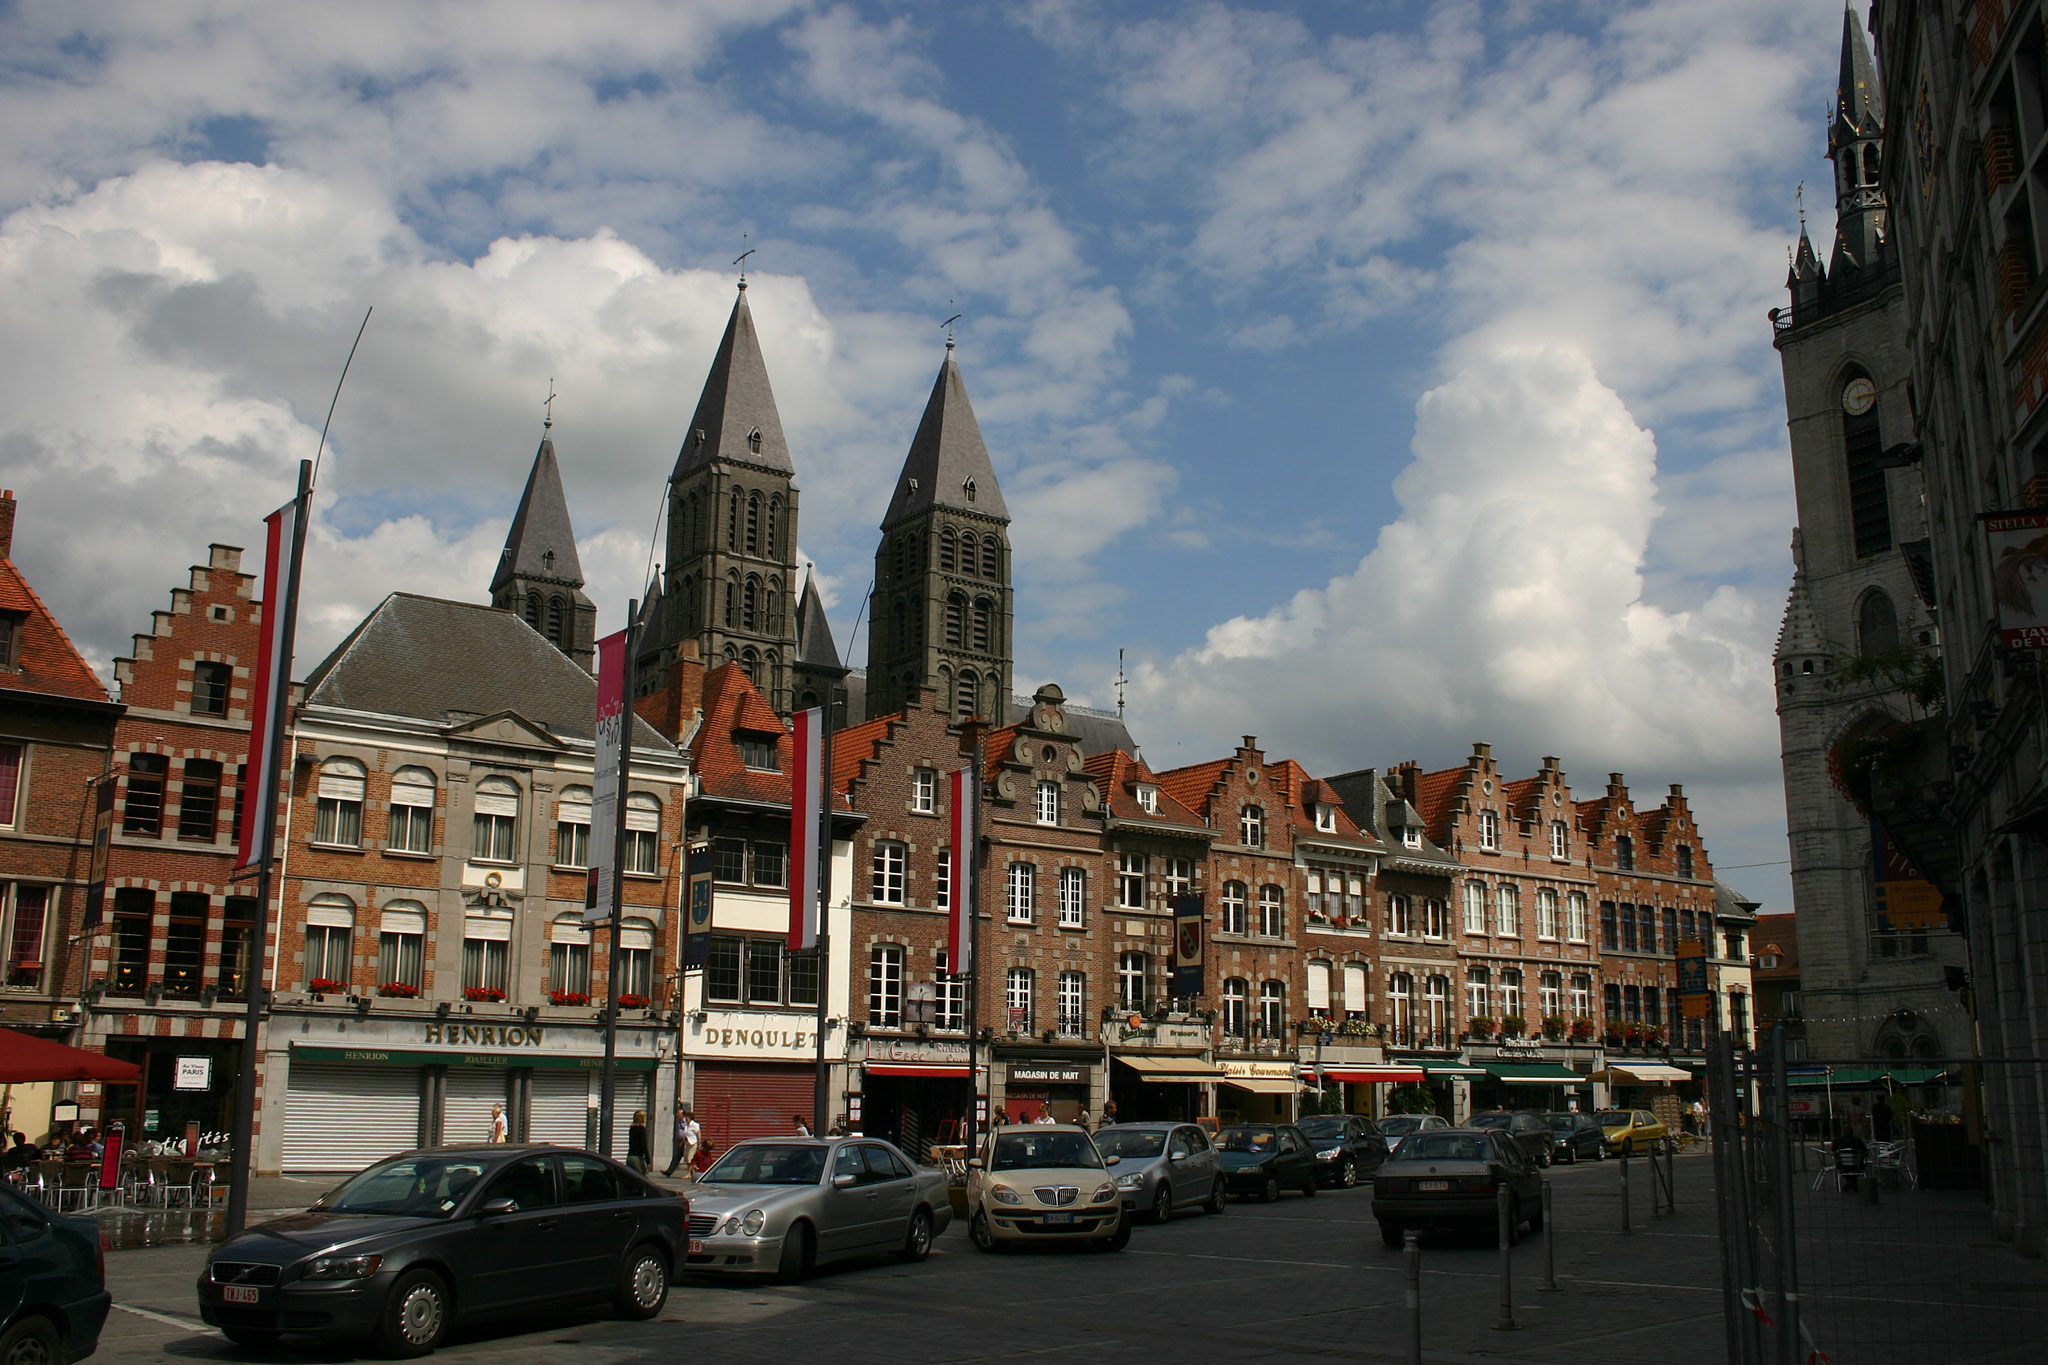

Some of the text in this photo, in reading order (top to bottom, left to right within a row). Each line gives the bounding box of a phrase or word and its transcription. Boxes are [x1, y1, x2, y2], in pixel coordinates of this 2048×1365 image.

[1988, 518, 2038, 531] STELLA
[2019, 628, 2048, 639] TAV
[2012, 638, 2033, 649] DE
[425, 1023, 543, 1047] HENRION
[705, 1027, 819, 1048] DENOULET
[345, 1051, 389, 1061] HENRION
[464, 1055, 508, 1065] JOAILLIER
[1014, 1070, 1080, 1080] MAGASIN DE NUIT
